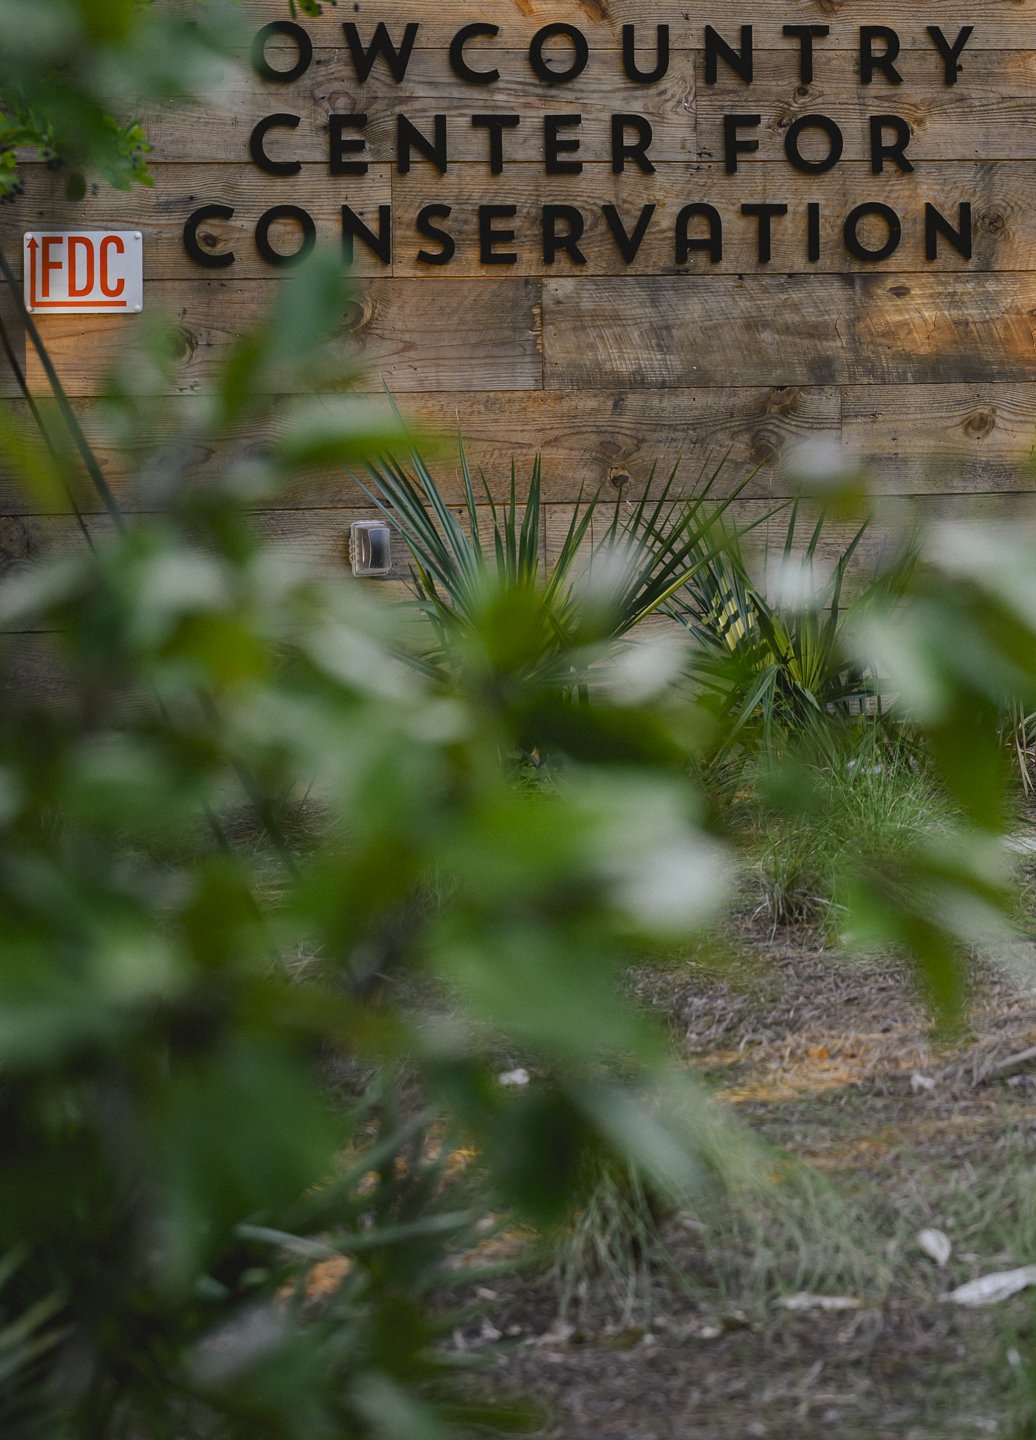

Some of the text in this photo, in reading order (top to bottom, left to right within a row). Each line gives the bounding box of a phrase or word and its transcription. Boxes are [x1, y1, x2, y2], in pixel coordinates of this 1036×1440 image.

[252, 20, 975, 84] OWCOUNTRY
[250, 112, 915, 176] CENTER FOR
[183, 201, 973, 267] CONSERVATION
[41, 235, 125, 298] FDC
